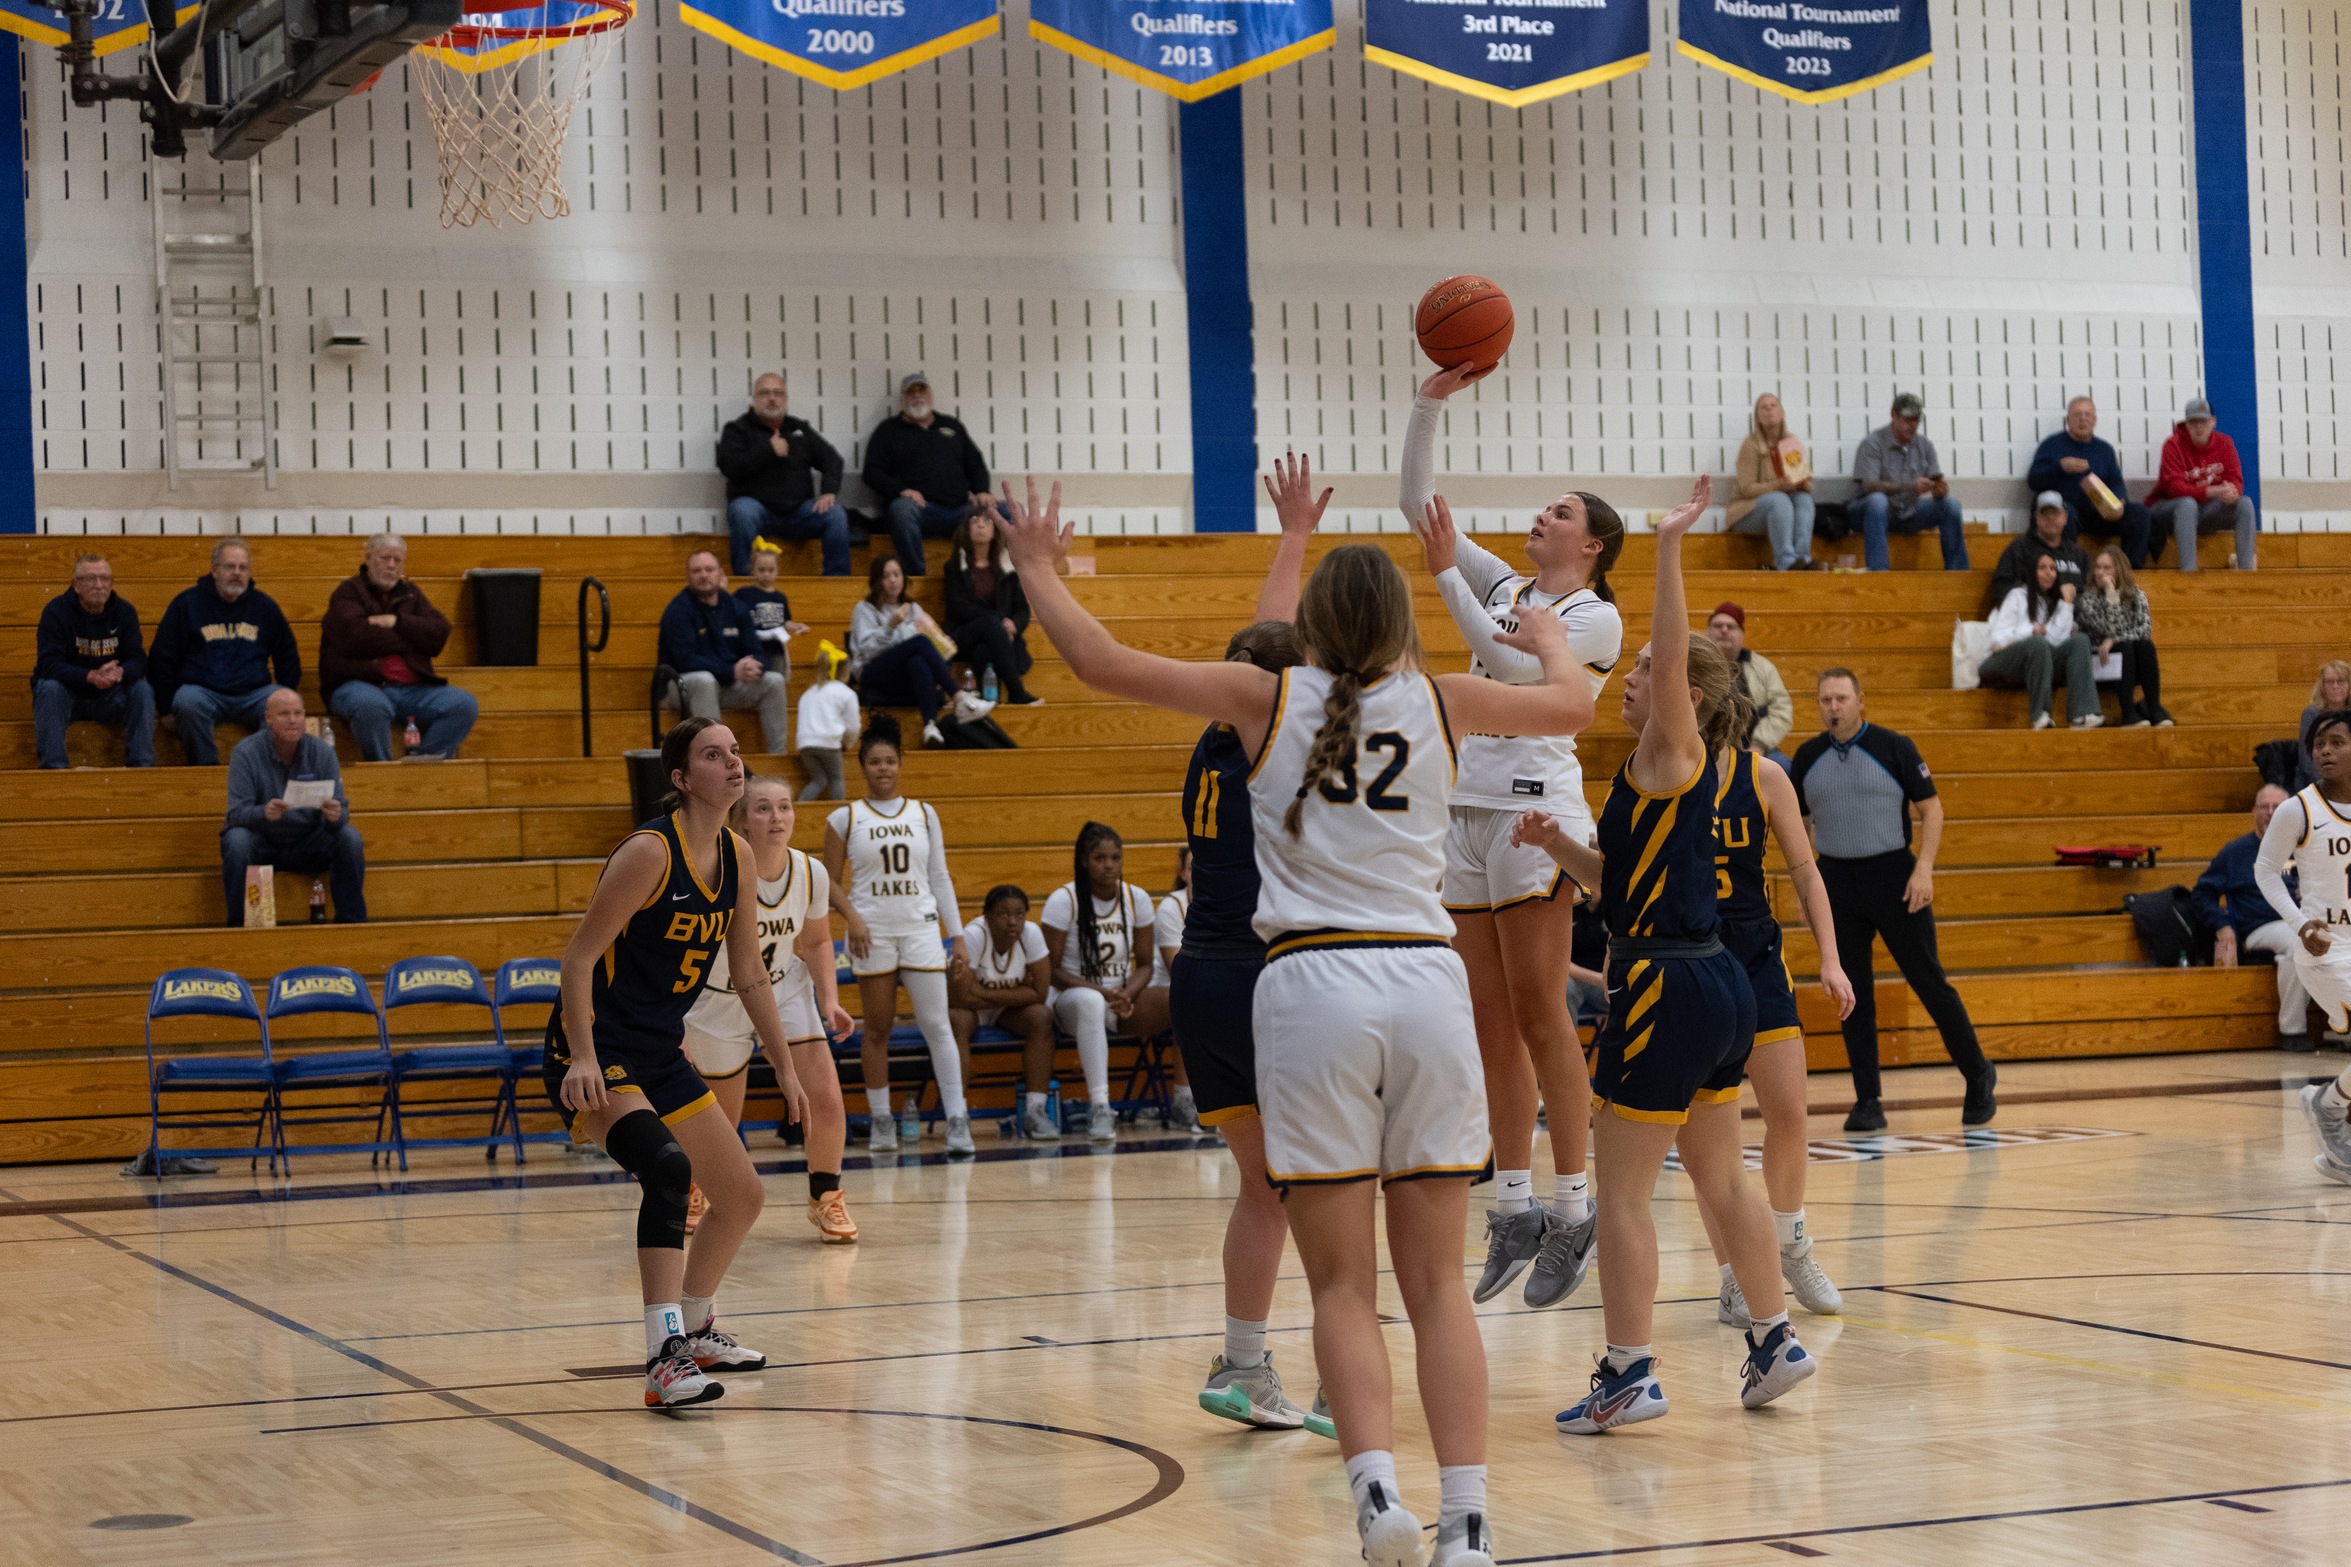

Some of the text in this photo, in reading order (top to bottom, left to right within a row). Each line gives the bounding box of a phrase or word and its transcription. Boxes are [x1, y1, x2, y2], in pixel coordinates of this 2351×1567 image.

[1714, 0, 1901, 23] National Tournament
[1131, 12, 1239, 36] Qualifiers
[1463, 14, 1555, 35] 3rd Place
[806, 28, 875, 54] 2000
[1762, 27, 1852, 50] Qualifiers
[1159, 45, 1213, 67] 2013
[1487, 43, 1533, 62] 2021
[1785, 56, 1832, 76] 2023
[1193, 767, 1221, 839] 11
[869, 824, 914, 840] IOWA
[2328, 837, 2351, 856] IO
[880, 843, 910, 875] 10
[1714, 855, 1733, 899] 5
[871, 880, 920, 897] LAKES
[664, 908, 735, 943] BVU
[756, 916, 795, 938] OWA
[398, 969, 474, 991] LAKERS
[673, 949, 709, 993] 5
[164, 979, 242, 1001] LAKERS
[280, 976, 356, 998] LAKERS
